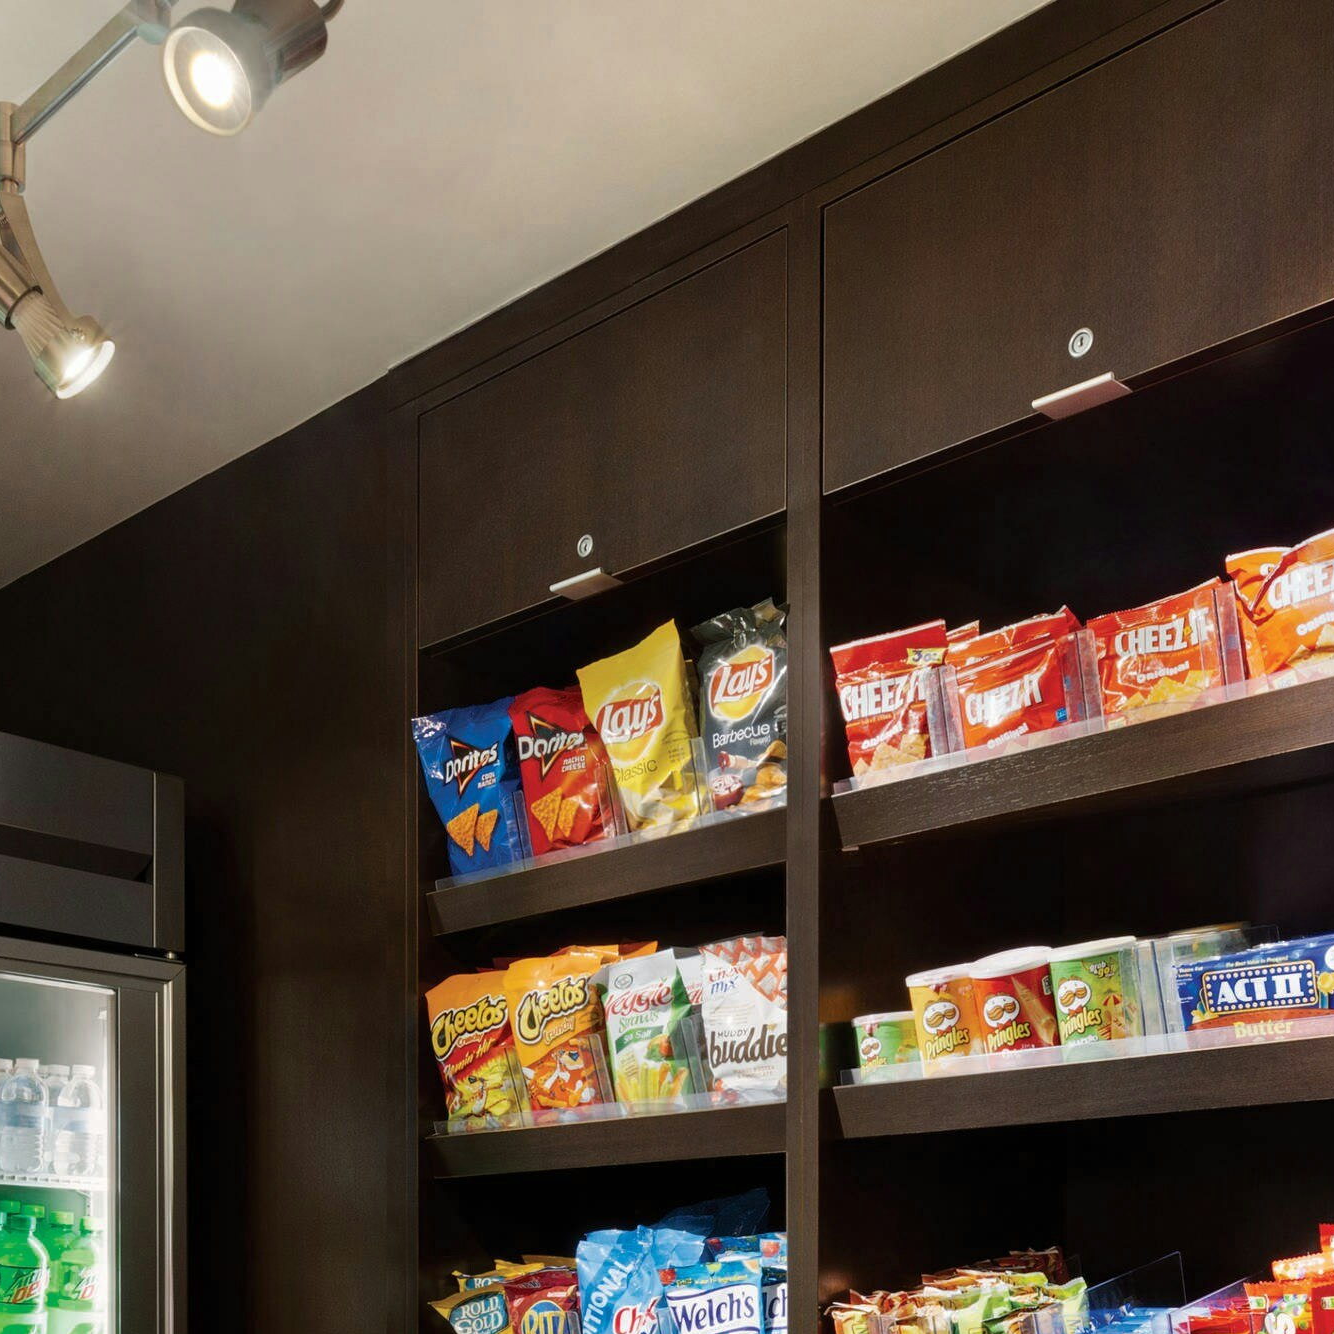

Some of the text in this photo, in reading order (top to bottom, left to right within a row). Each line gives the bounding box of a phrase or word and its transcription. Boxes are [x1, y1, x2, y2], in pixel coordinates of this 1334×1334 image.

[711, 722, 771, 750] Barbecue
[445, 744, 499, 780] Doritos
[561, 762, 587, 774] CHEESE
[562, 755, 586, 765] NACHO
[1217, 976, 1268, 1005] ACT
[516, 976, 589, 1045] Cheetos
[1233, 1018, 1295, 1040] Butter
[711, 1024, 787, 1069] buddie
[459, 1299, 500, 1320] ROLD
[671, 1290, 755, 1333] Welch's
